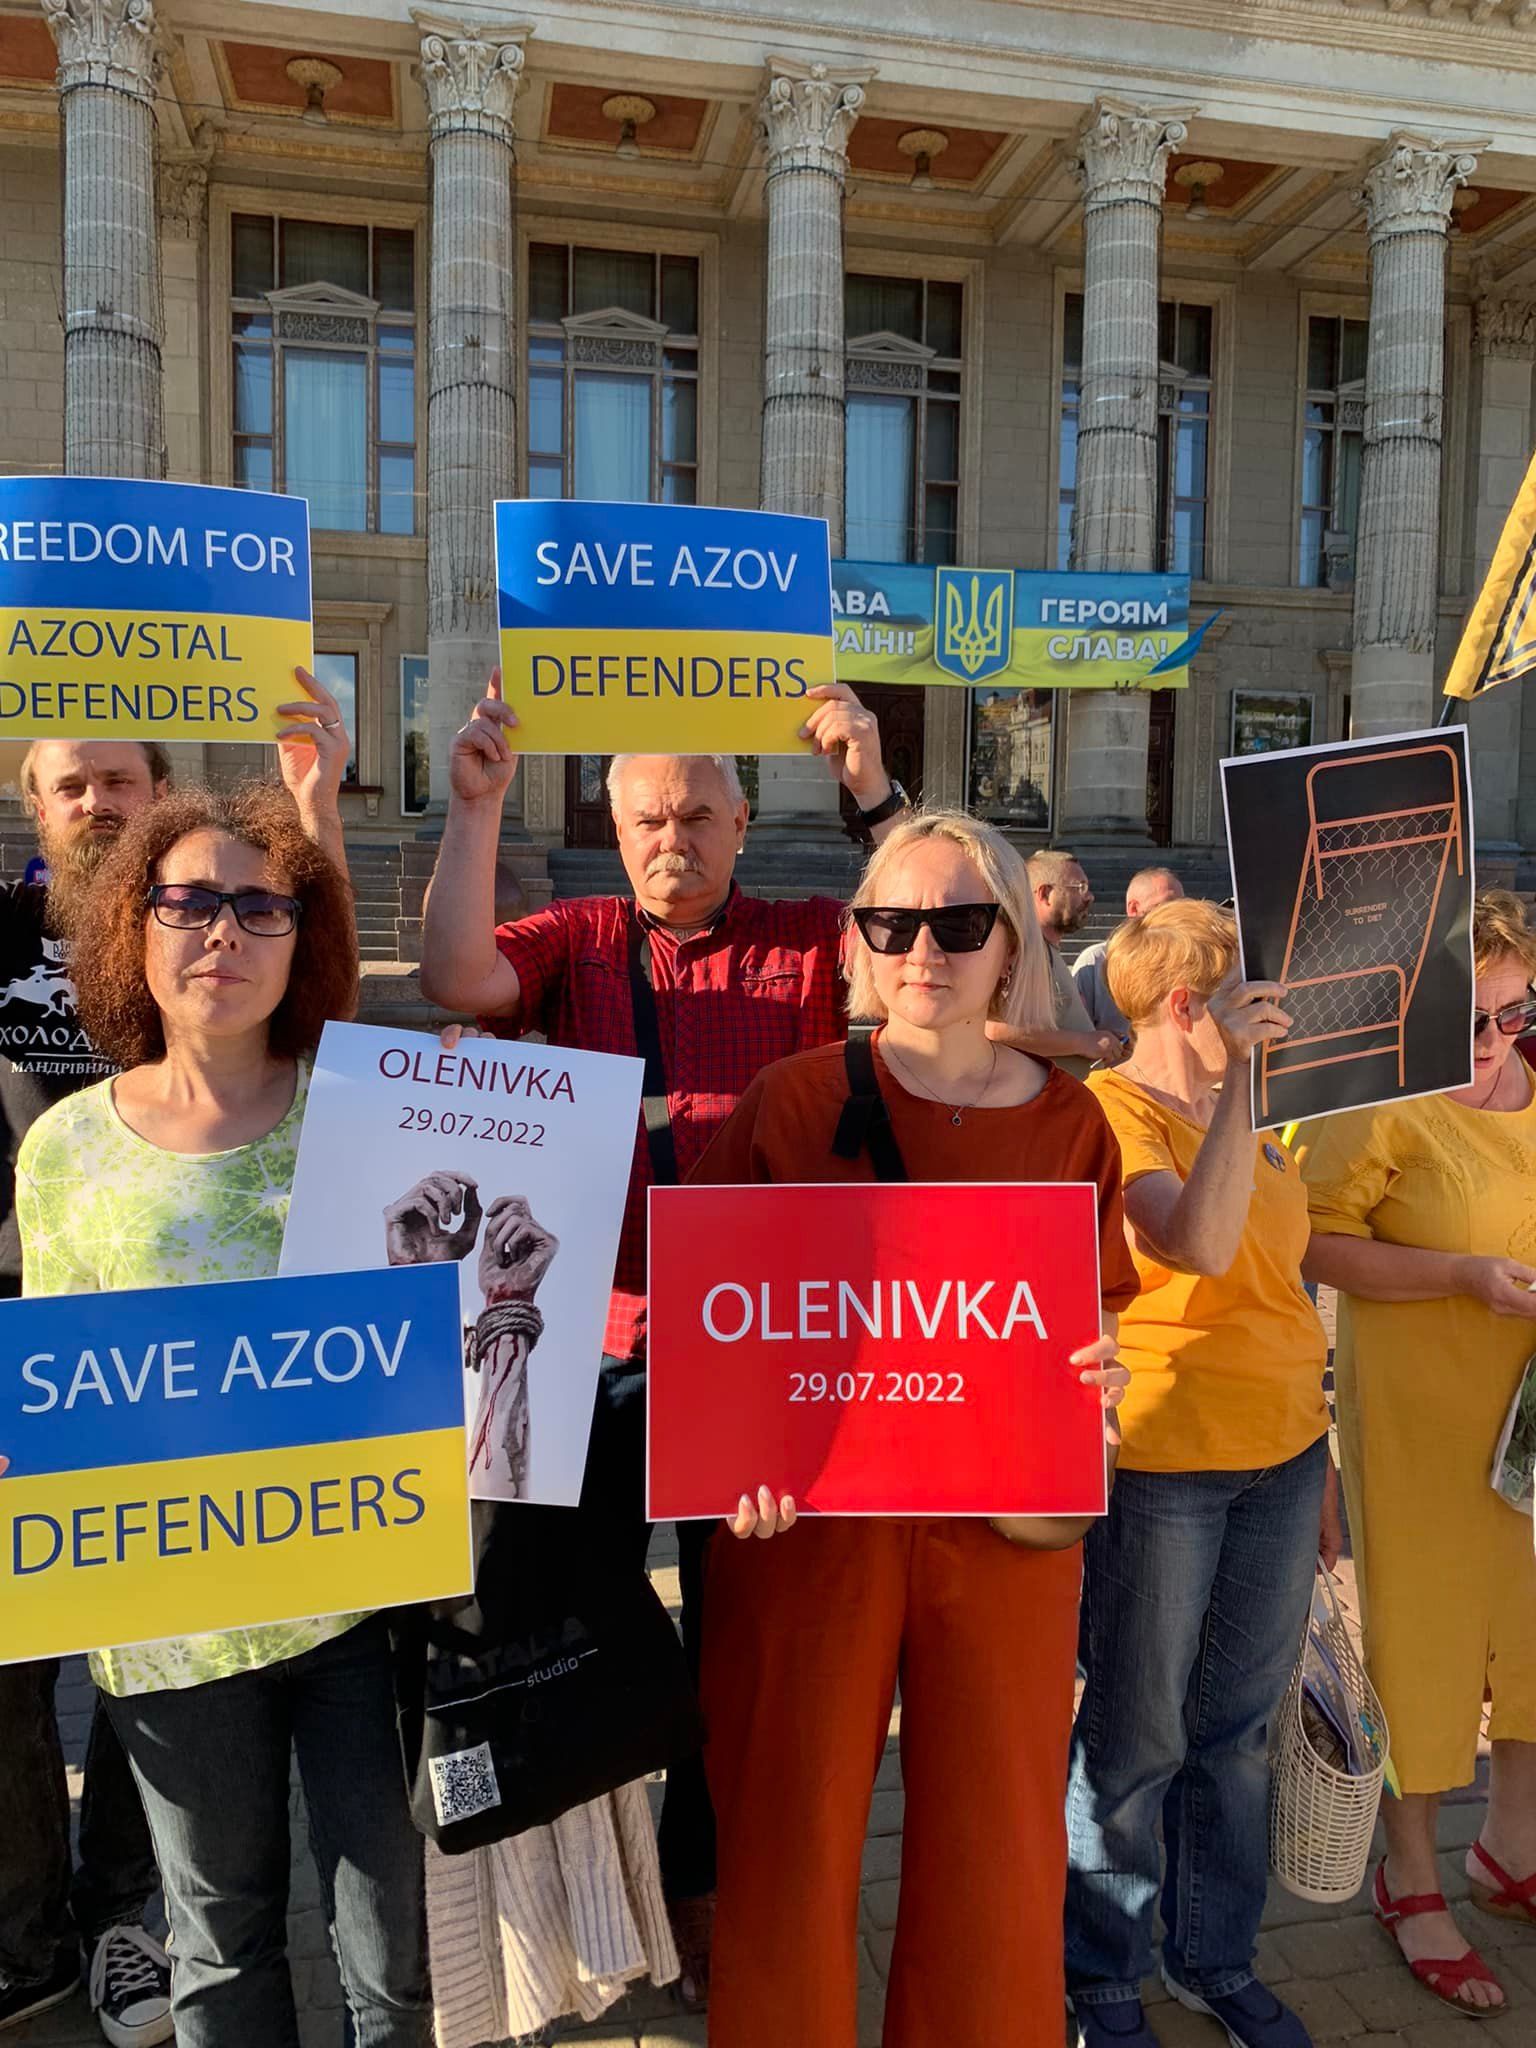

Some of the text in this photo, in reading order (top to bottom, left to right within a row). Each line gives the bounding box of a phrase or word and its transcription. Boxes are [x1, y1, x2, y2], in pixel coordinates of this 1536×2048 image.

[205, 529, 296, 576] FOR
[536, 541, 798, 593] SAVE AZOV
[1040, 598, 1169, 626] ГЕРОЯМ
[7, 619, 243, 662] AZOVSTAL
[1047, 635, 1169, 662] СЛАВА!
[530, 655, 808, 699] DEFENDERS
[0, 681, 260, 723] DEFENDERS
[1353, 917, 1364, 925] TO
[378, 1048, 576, 1104] OLENIVKA
[398, 1106, 546, 1148] 29.07.2022
[702, 1280, 1049, 1342] OLENIVKA
[21, 1320, 411, 1414] SAVE AZOV
[788, 1372, 966, 1402] 29.07.2022
[12, 1468, 426, 1576] DEFENDERS
[526, 1656, 580, 1688] studio
